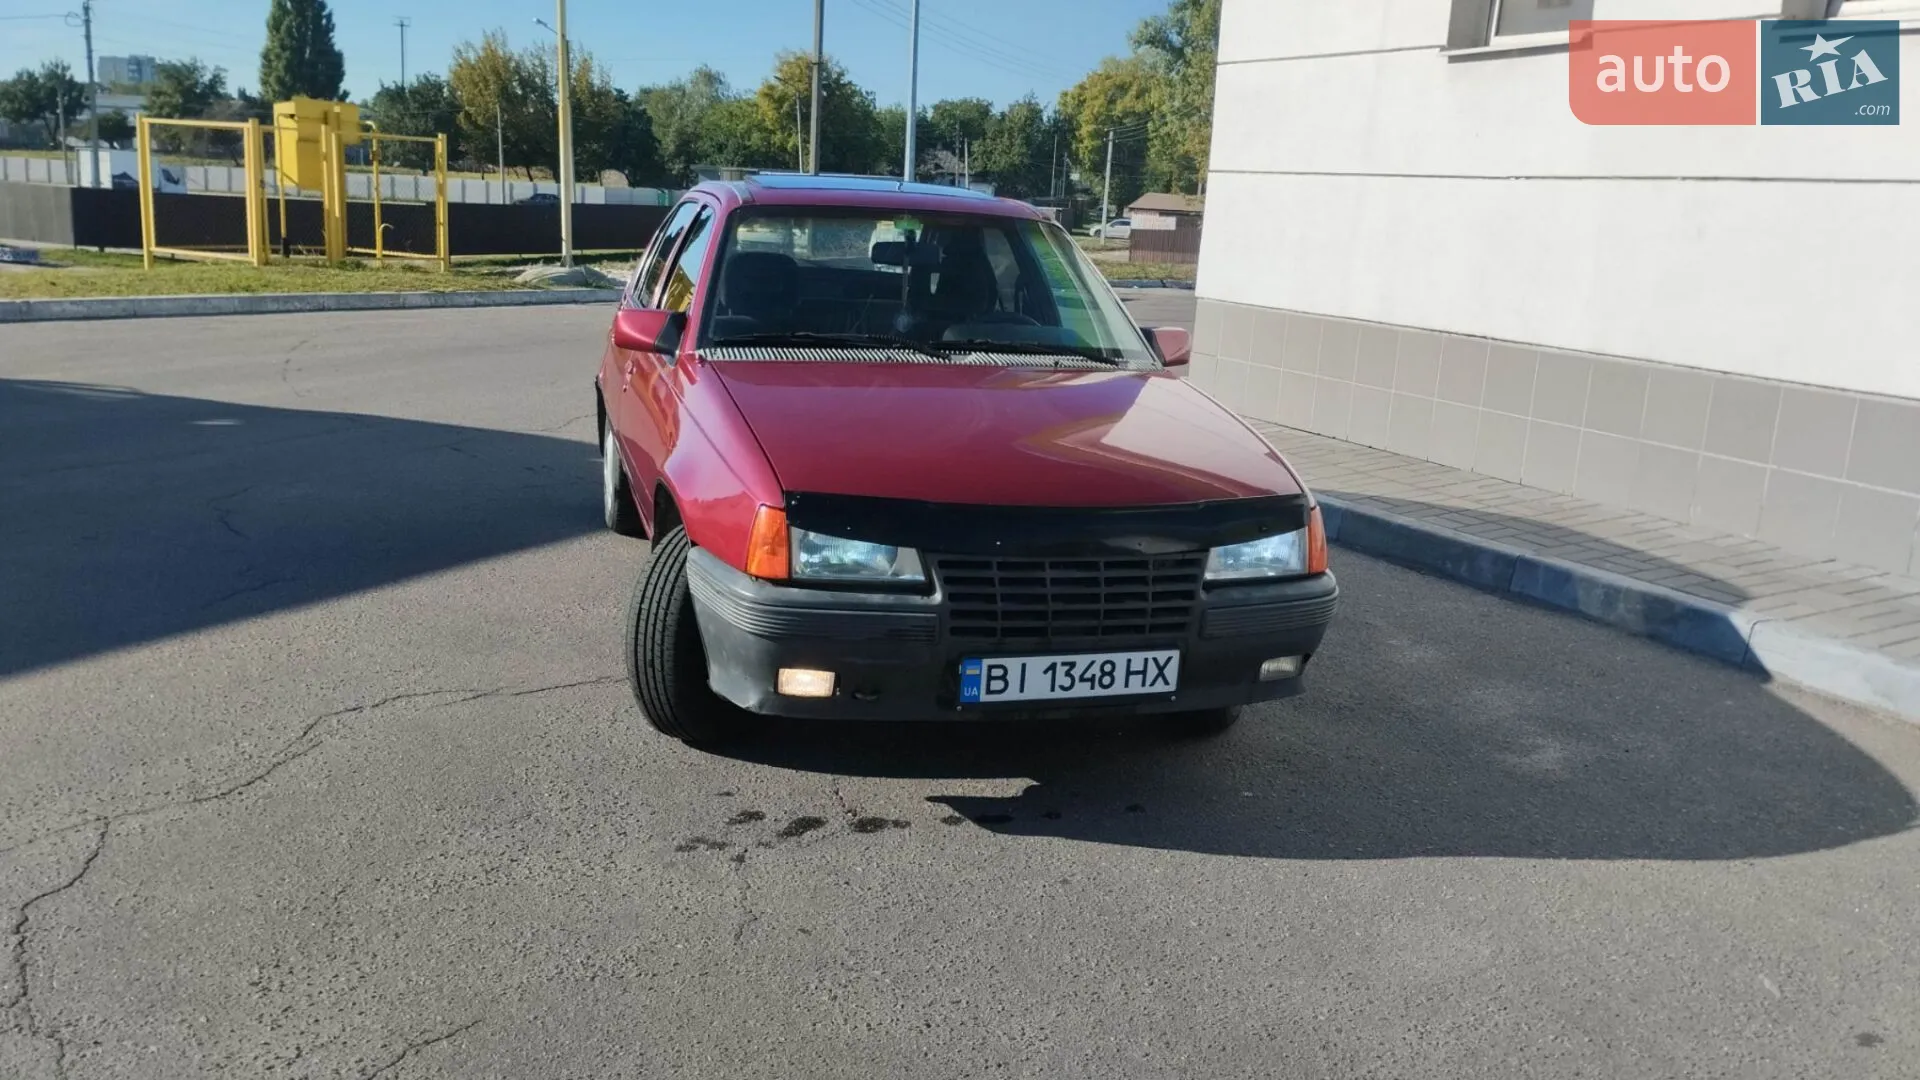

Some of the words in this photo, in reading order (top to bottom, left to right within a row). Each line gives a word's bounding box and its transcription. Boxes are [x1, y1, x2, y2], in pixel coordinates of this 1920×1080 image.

[1043, 660, 1116, 692] 1348
[1124, 656, 1174, 688] HX
[964, 687, 978, 697] UA
